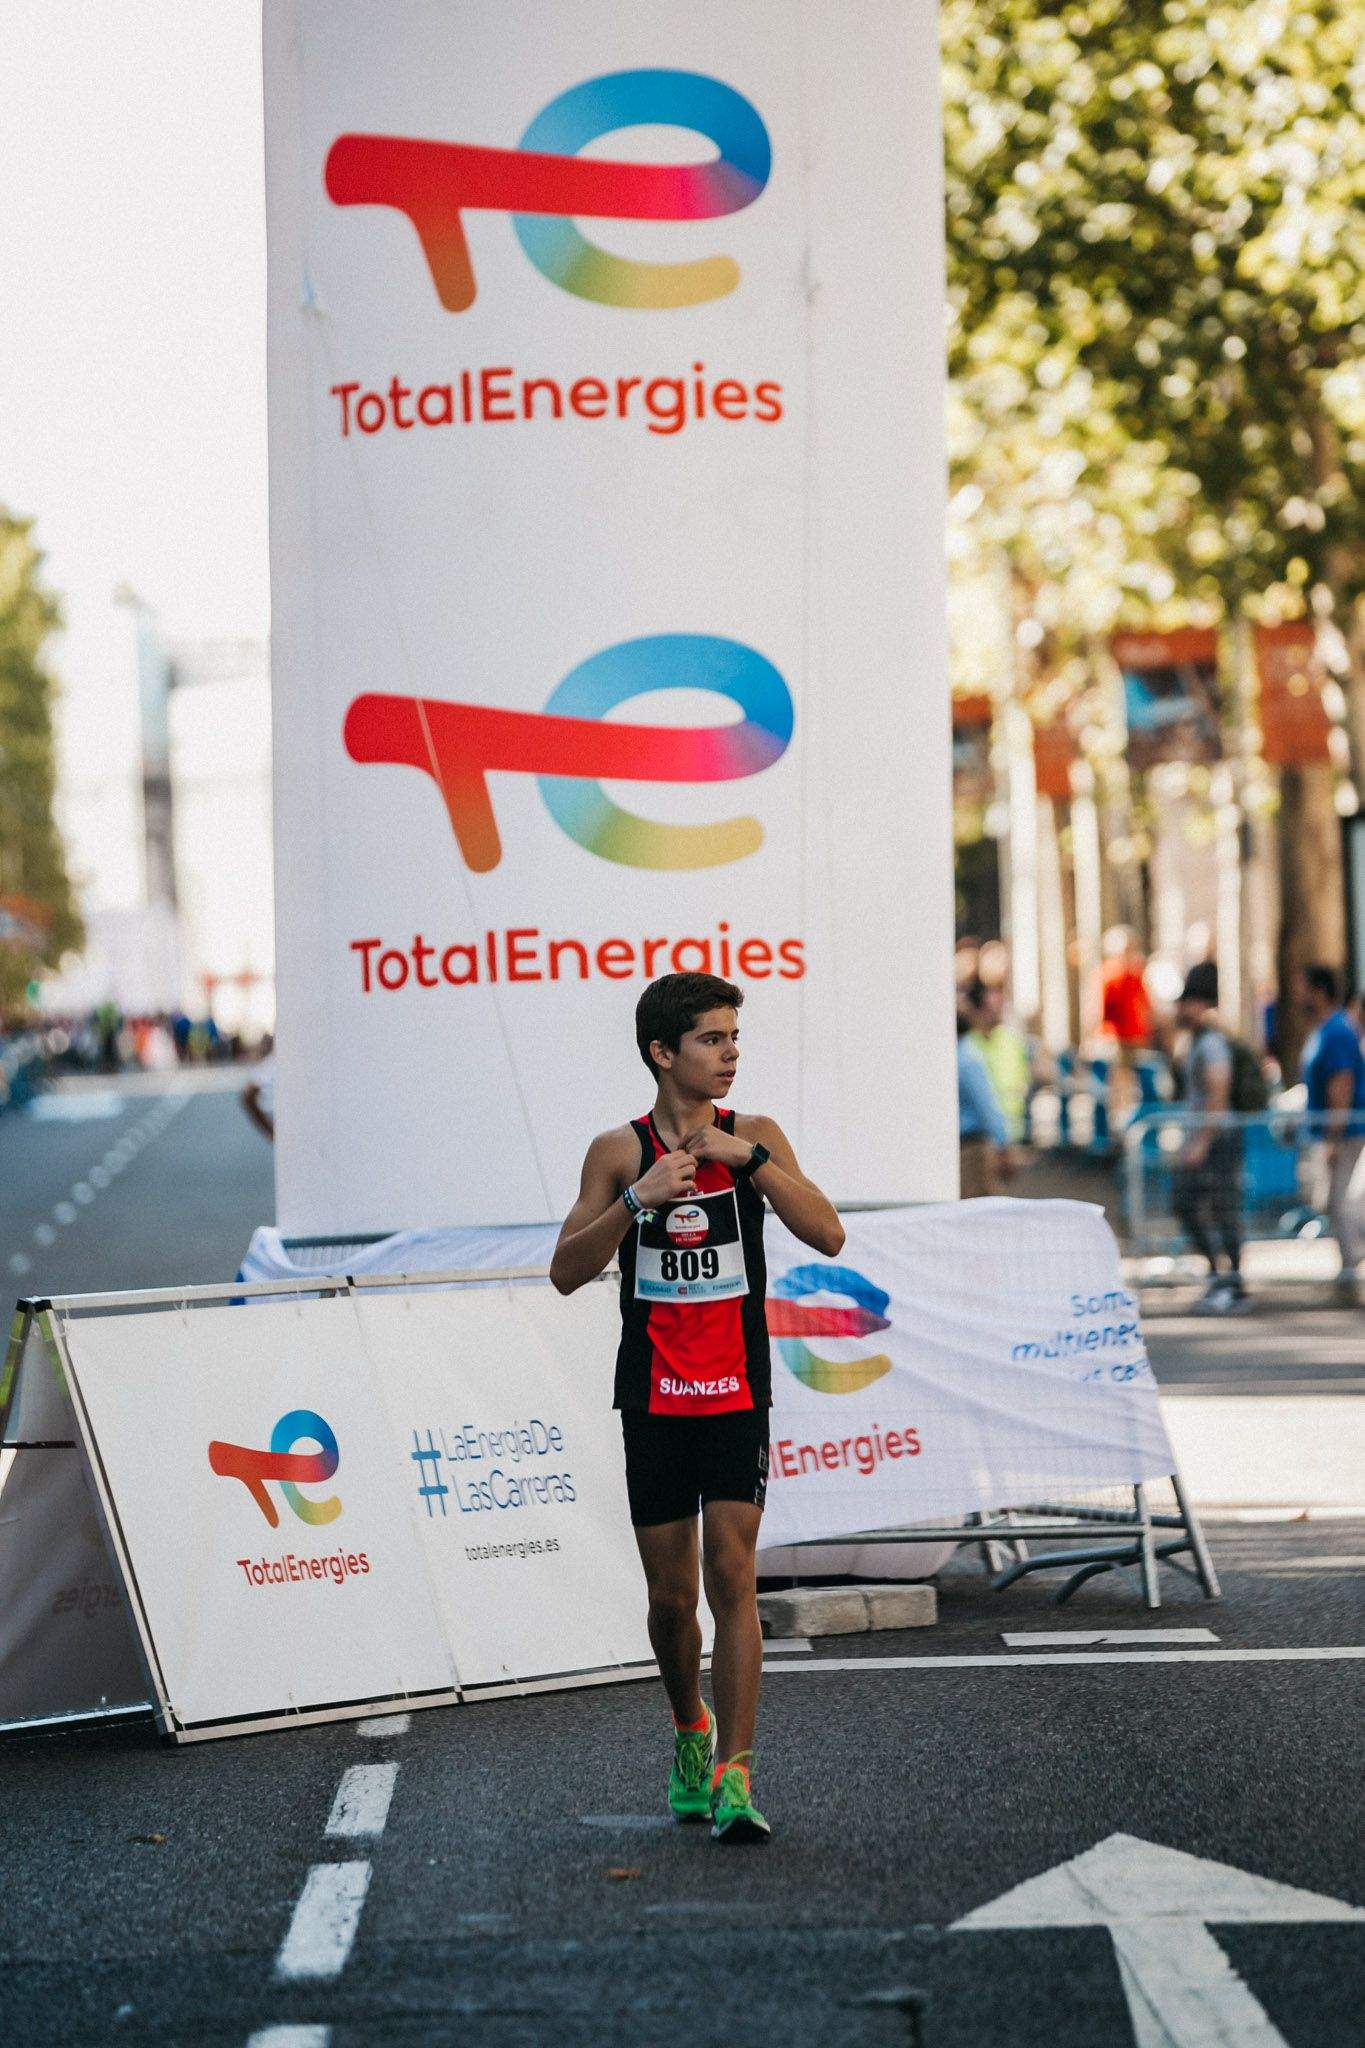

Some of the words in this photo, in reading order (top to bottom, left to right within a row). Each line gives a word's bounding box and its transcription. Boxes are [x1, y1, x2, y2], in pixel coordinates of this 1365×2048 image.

[330, 361, 784, 437] TotalEnergies
[660, 1248, 719, 1282] 809
[660, 1376, 740, 1395] SUANZES
[236, 1547, 370, 1586] TotalEnergies
[465, 1538, 560, 1561] totalenergies.es
